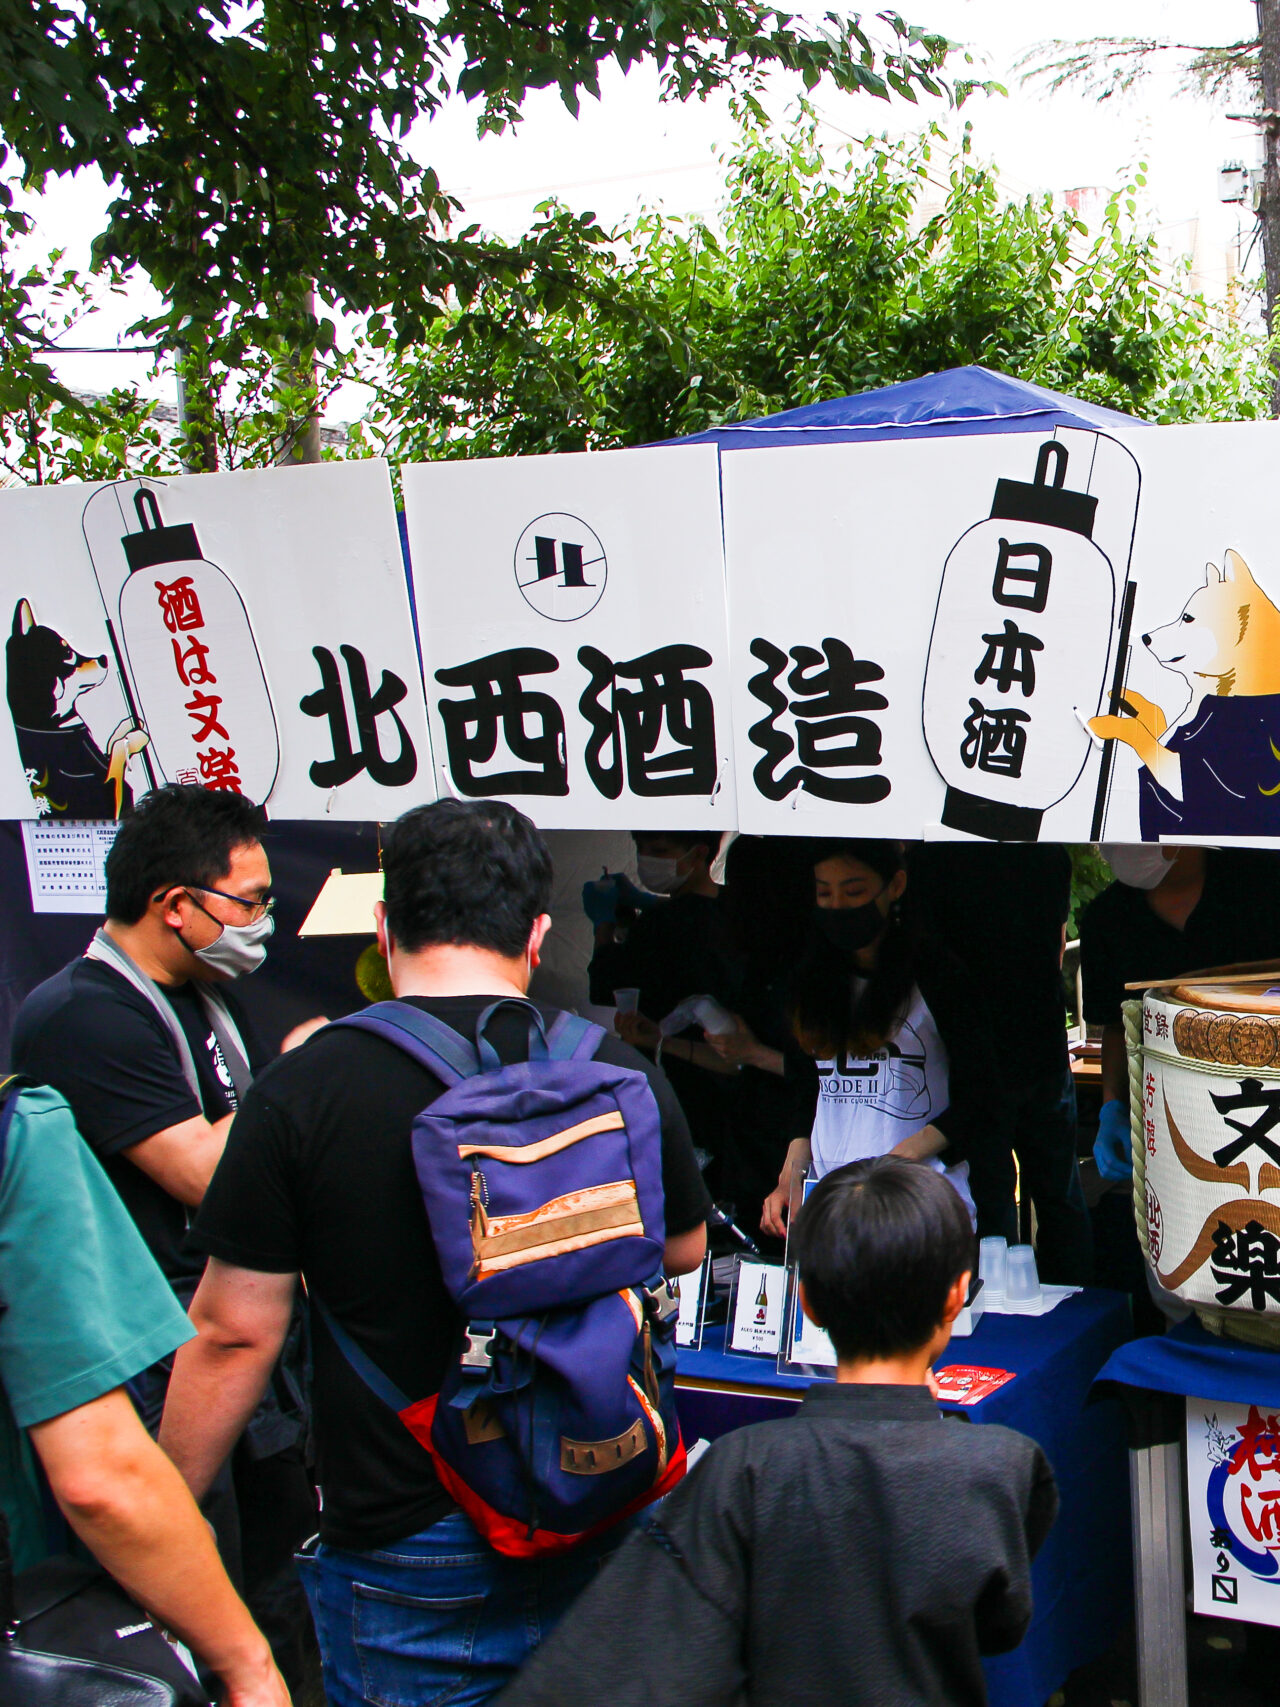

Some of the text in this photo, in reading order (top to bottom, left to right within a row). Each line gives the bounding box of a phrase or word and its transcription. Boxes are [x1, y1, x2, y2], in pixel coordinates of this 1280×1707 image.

[959, 538, 1053, 779] 日本酒
[300, 636, 893, 804] 北西酒造
[869, 1080, 879, 1093] II
[115, 1621, 153, 1639] Nikon
